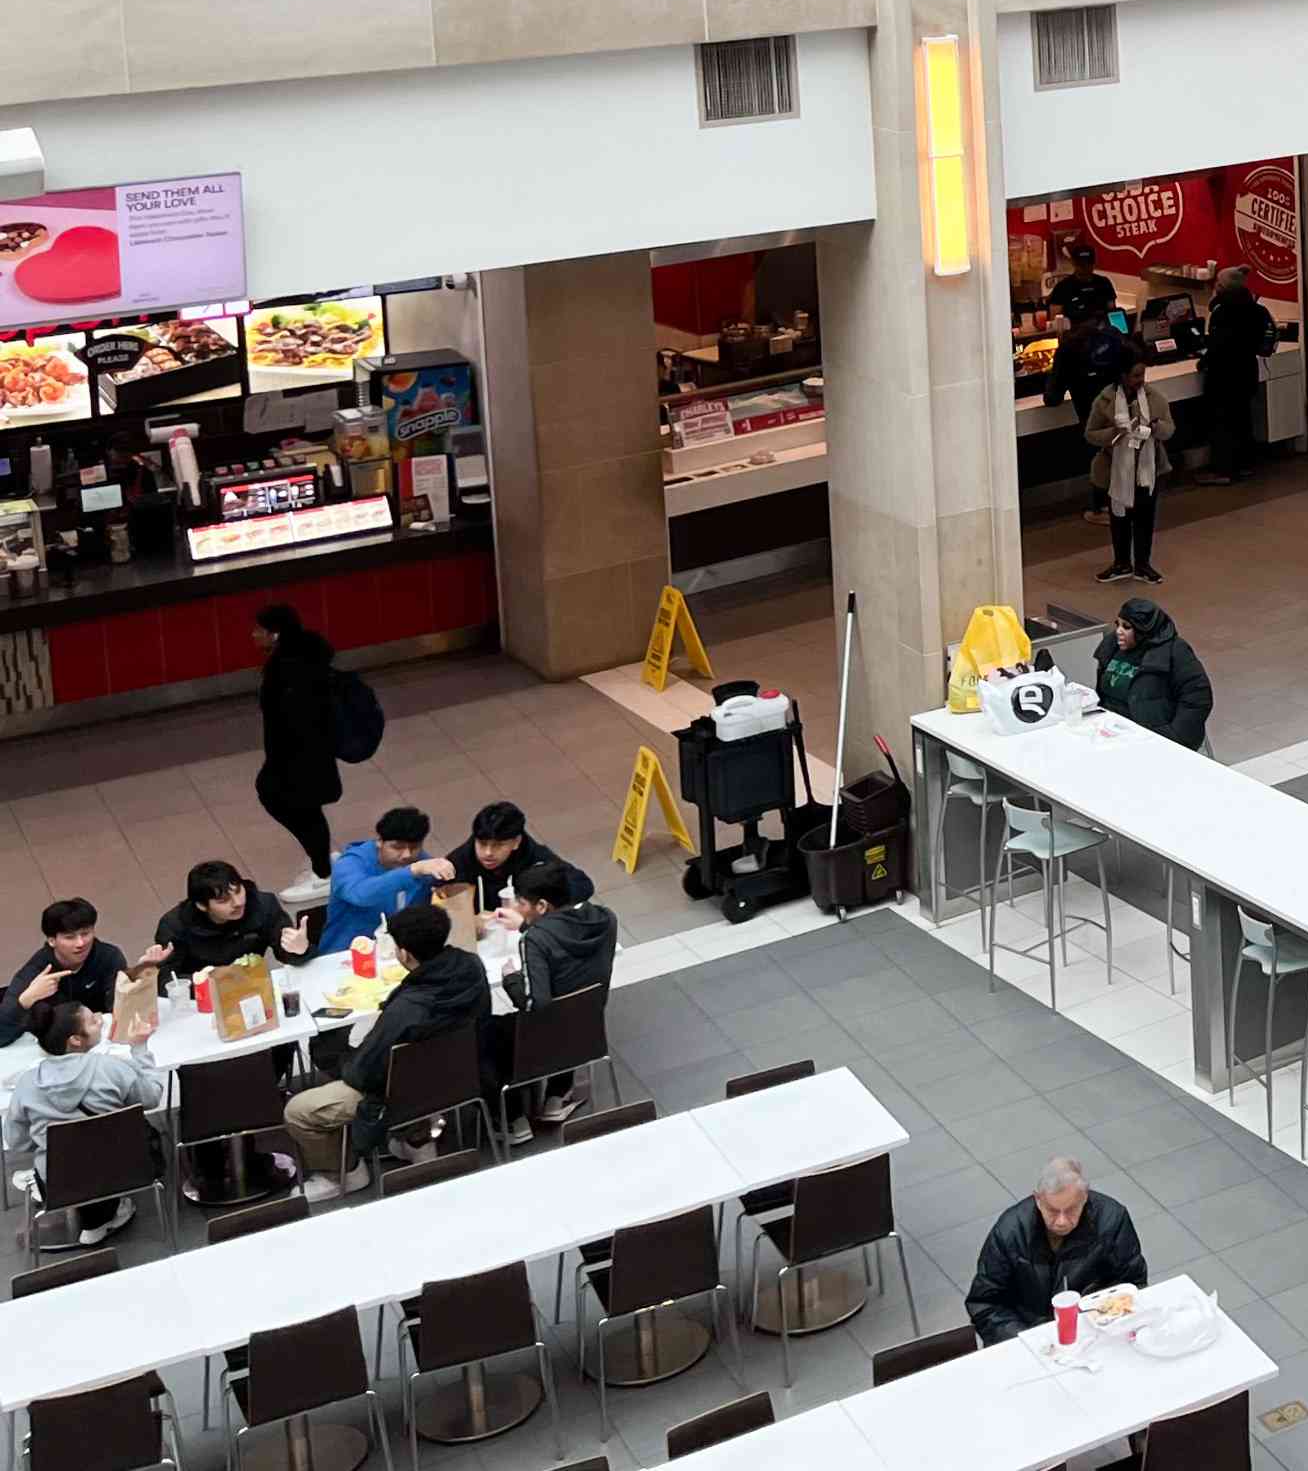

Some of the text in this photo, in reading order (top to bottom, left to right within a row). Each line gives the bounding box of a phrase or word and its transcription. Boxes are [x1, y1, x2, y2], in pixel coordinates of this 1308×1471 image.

[126, 184, 224, 202] SEND THEM ALL
[126, 196, 197, 213] YOUR LOVE
[1092, 190, 1177, 227] CHOICE
[1116, 219, 1158, 239] STEAK
[400, 408, 458, 436] snapple
